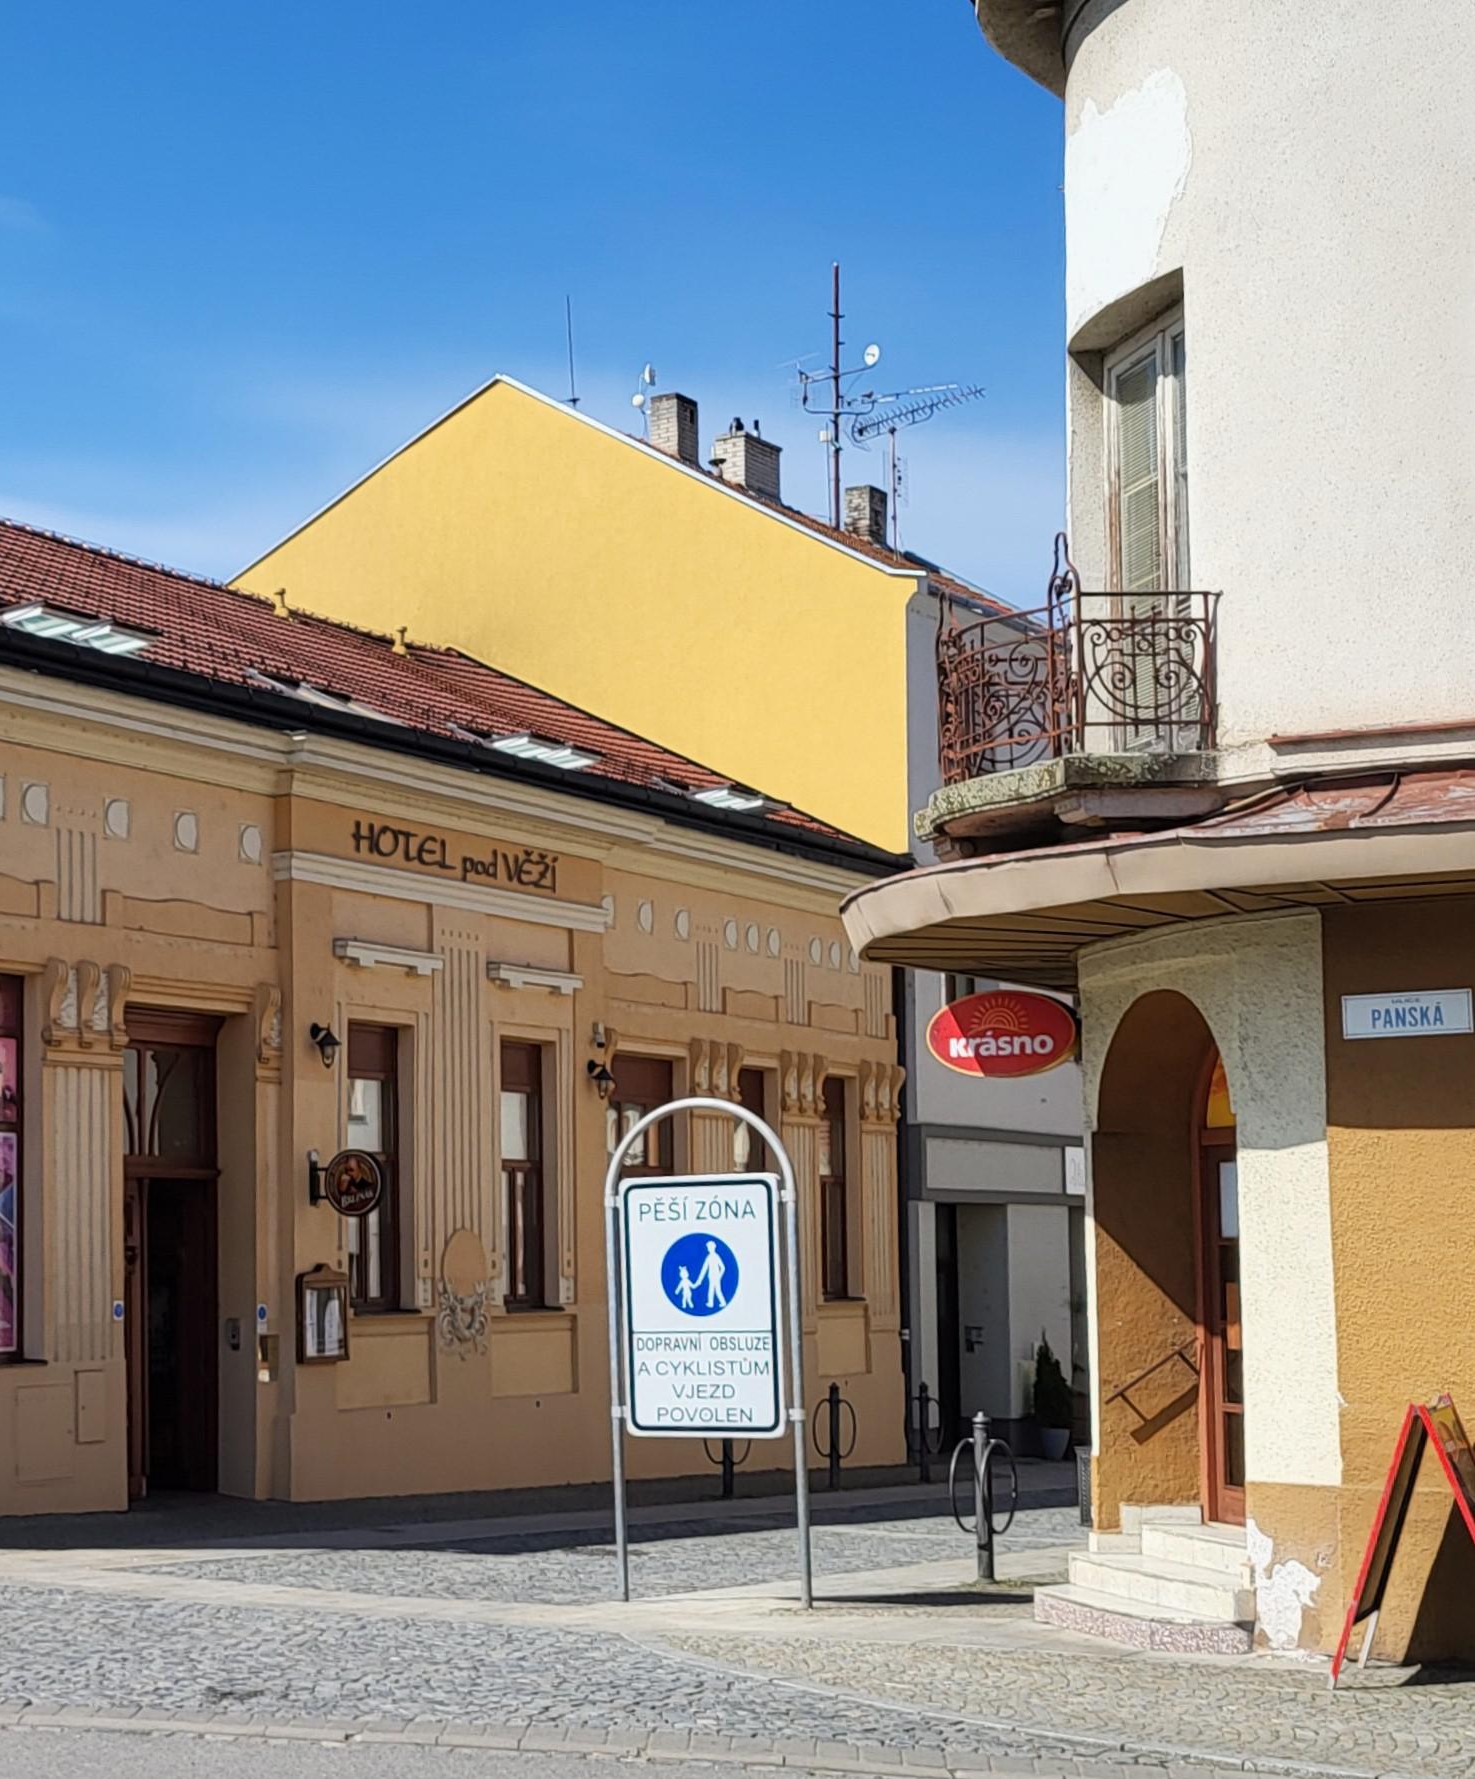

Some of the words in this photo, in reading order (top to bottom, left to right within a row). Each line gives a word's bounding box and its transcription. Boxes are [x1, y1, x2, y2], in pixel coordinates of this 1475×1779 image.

[351, 820, 456, 870] HOTEL
[462, 849, 497, 882] pod
[502, 849, 558, 893] VĚŽÍ
[1371, 1001, 1445, 1029] PANSKÁ
[639, 1197, 688, 1222] PĚŠÍ
[695, 1195, 756, 1220] ZÓNA
[637, 1333, 702, 1351] DOPRAVNÍ
[710, 1336, 770, 1351] OBSLUZE
[638, 1361, 651, 1377] A
[656, 1357, 769, 1377] CYKLISTŮM
[672, 1384, 736, 1400] VJEZD
[657, 1407, 753, 1423] POVOLEN
